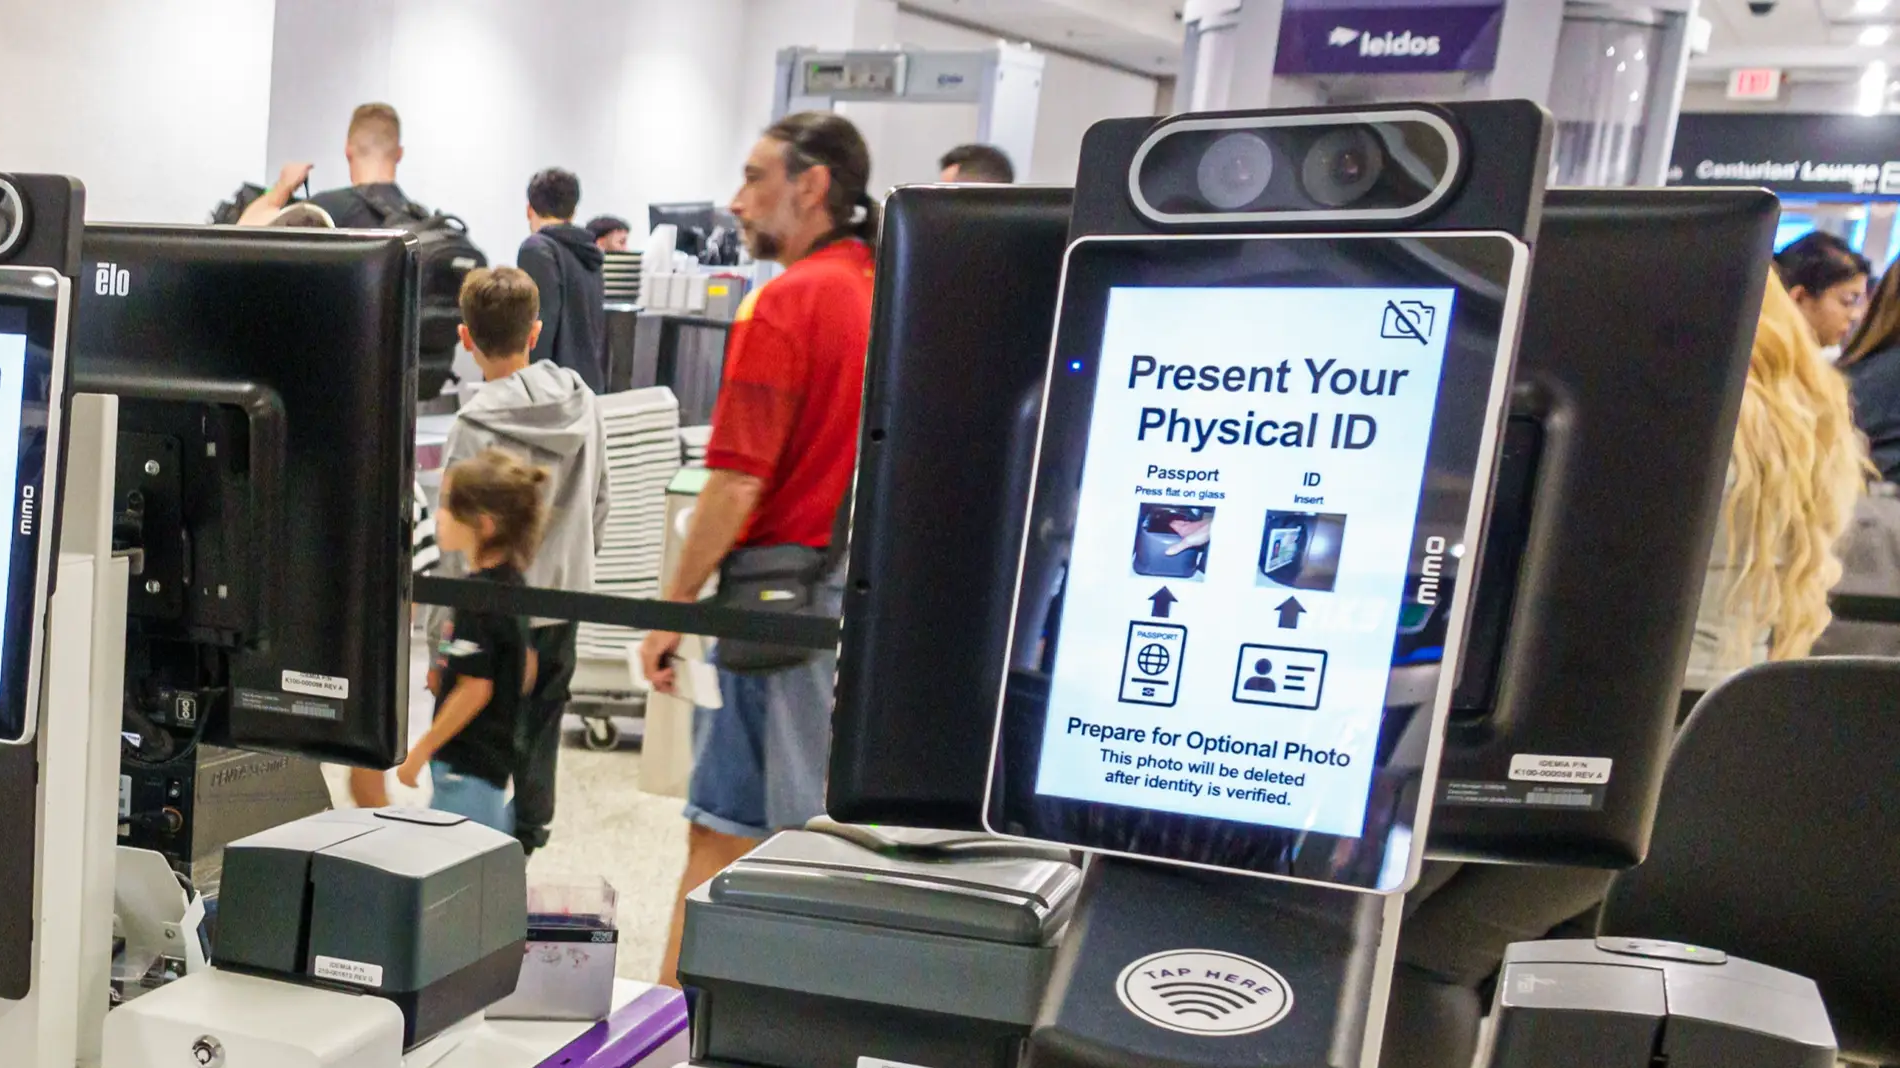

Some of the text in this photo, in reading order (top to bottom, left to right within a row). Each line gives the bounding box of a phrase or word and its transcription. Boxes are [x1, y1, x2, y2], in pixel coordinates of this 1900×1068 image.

[1359, 30, 1441, 56] leidos
[1801, 160, 1880, 190] Lounge
[1128, 355, 1410, 396] Present Your
[1137, 407, 1377, 453] Physical ID
[1146, 464, 1220, 483] Passport
[1303, 472, 1321, 487] ID
[1135, 485, 1163, 496] Press
[1166, 487, 1180, 496] flat
[1199, 489, 1225, 500] glass
[1294, 494, 1324, 505] Insert
[20, 485, 34, 535] mimo
[1417, 536, 1445, 605] mimo
[1137, 631, 1178, 640] PASSPORT
[1067, 717, 1351, 767] Prepare for Optional Photo
[1100, 748, 1305, 787] This photo will be deleted
[1575, 771, 1595, 779] REV
[1105, 770, 1291, 806] after identity is verified.
[1143, 968, 1272, 996] TAP HERE
